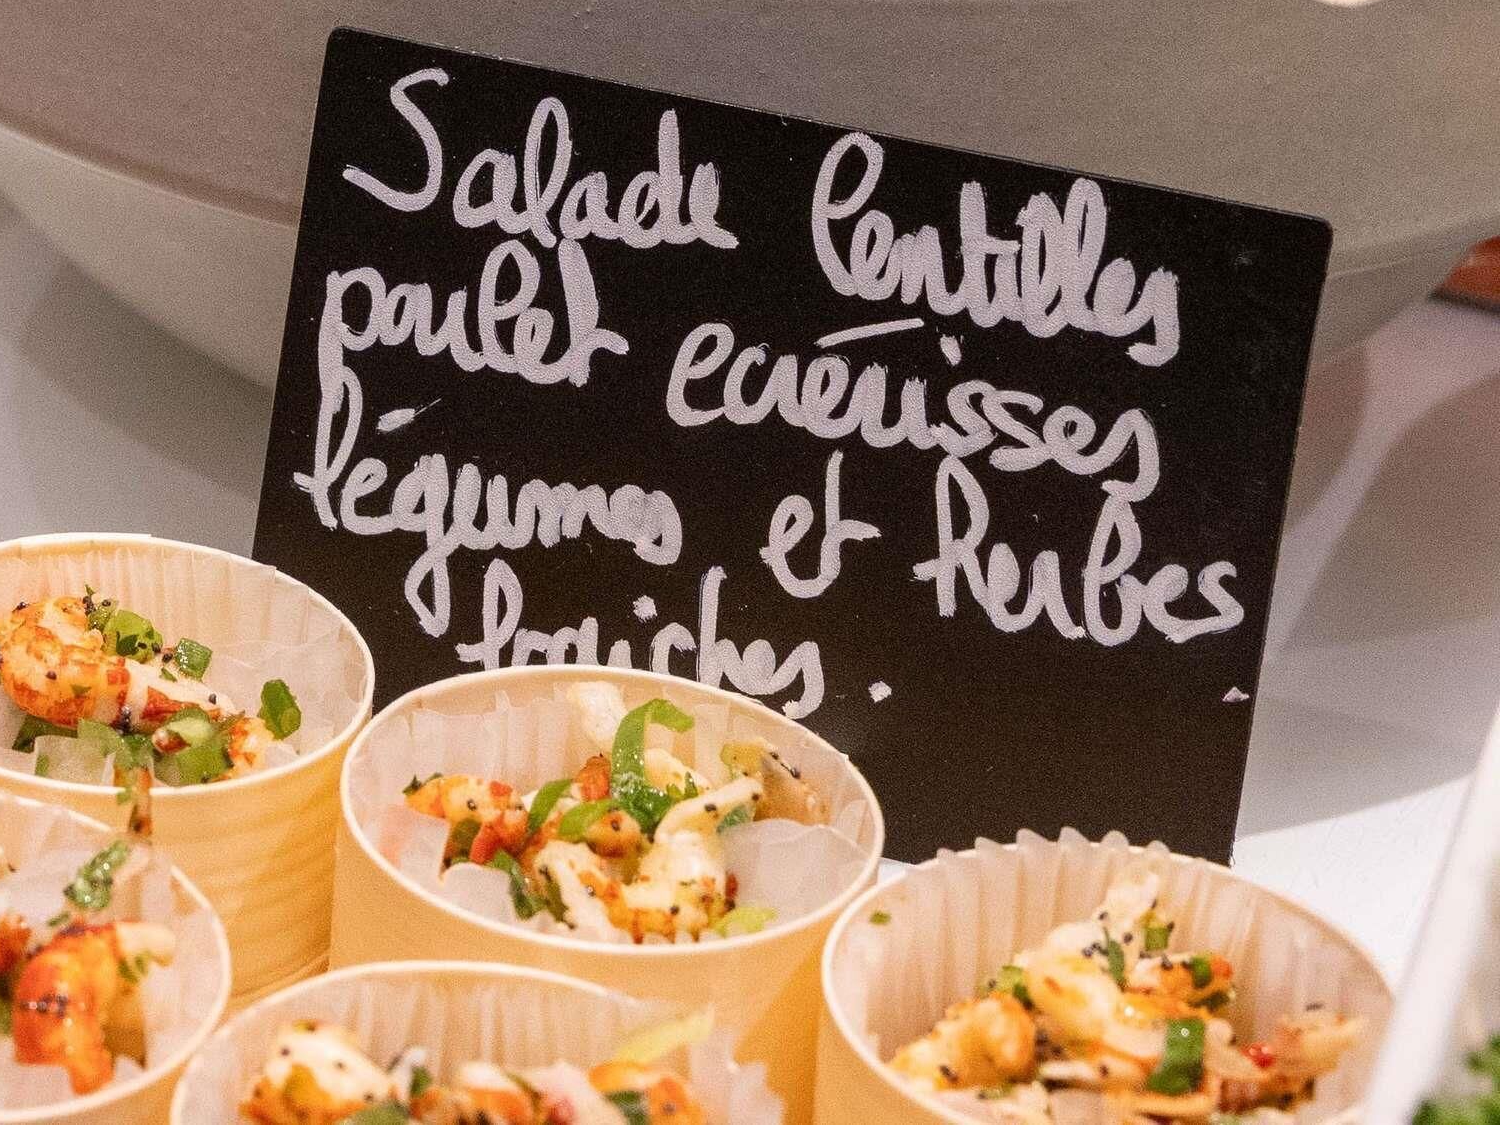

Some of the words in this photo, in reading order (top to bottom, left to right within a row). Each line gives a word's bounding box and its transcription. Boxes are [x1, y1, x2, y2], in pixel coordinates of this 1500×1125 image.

[317, 238, 630, 413] poulet
[342, 67, 740, 249] Salade
[811, 132, 1181, 367] lentilles
[293, 366, 683, 637] légumes
[759, 450, 881, 598] et
[912, 455, 1245, 647] herbes
